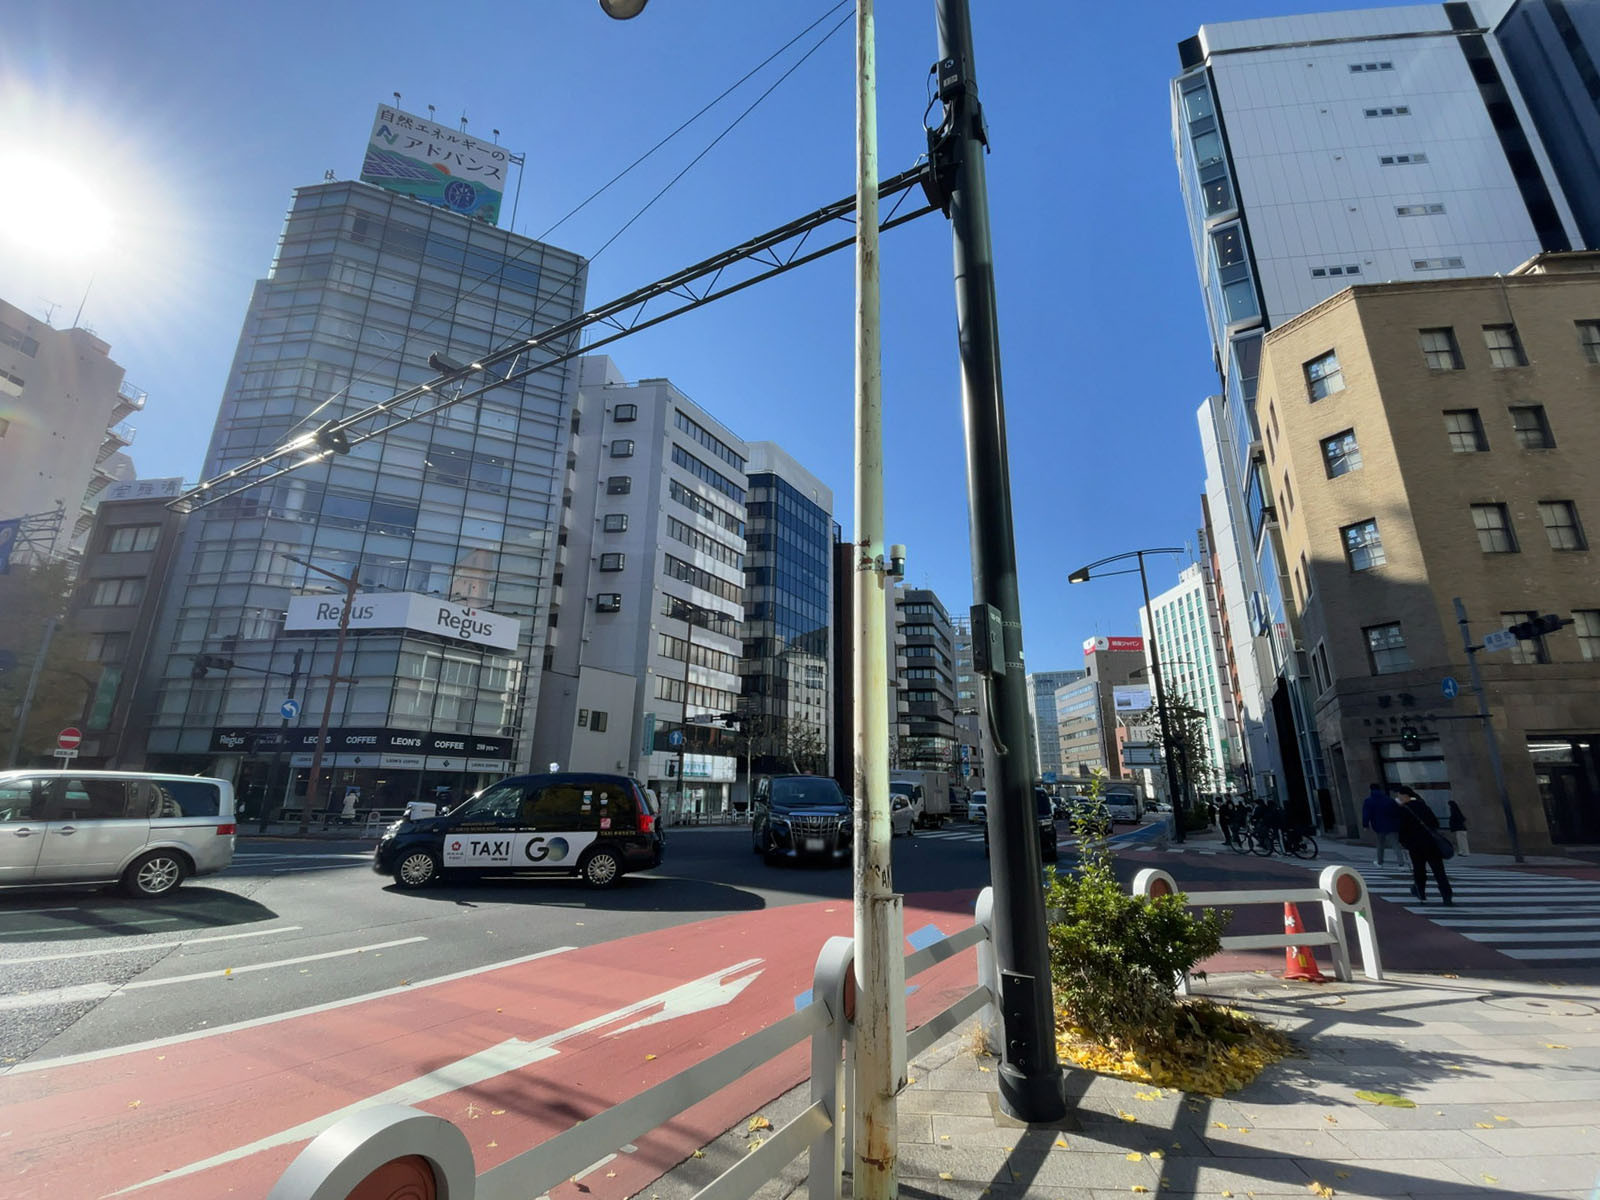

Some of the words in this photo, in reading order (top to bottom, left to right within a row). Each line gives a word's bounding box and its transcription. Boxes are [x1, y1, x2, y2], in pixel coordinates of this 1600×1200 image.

[380, 109, 505, 161] 自然エネルギーの
[403, 135, 500, 180] アドバンス
[437, 607, 493, 639] Regus
[346, 736, 377, 744] COFFEE
[391, 737, 421, 747] LEON'S
[434, 741, 464, 750] COFFEE
[470, 841, 510, 856] TAXI
